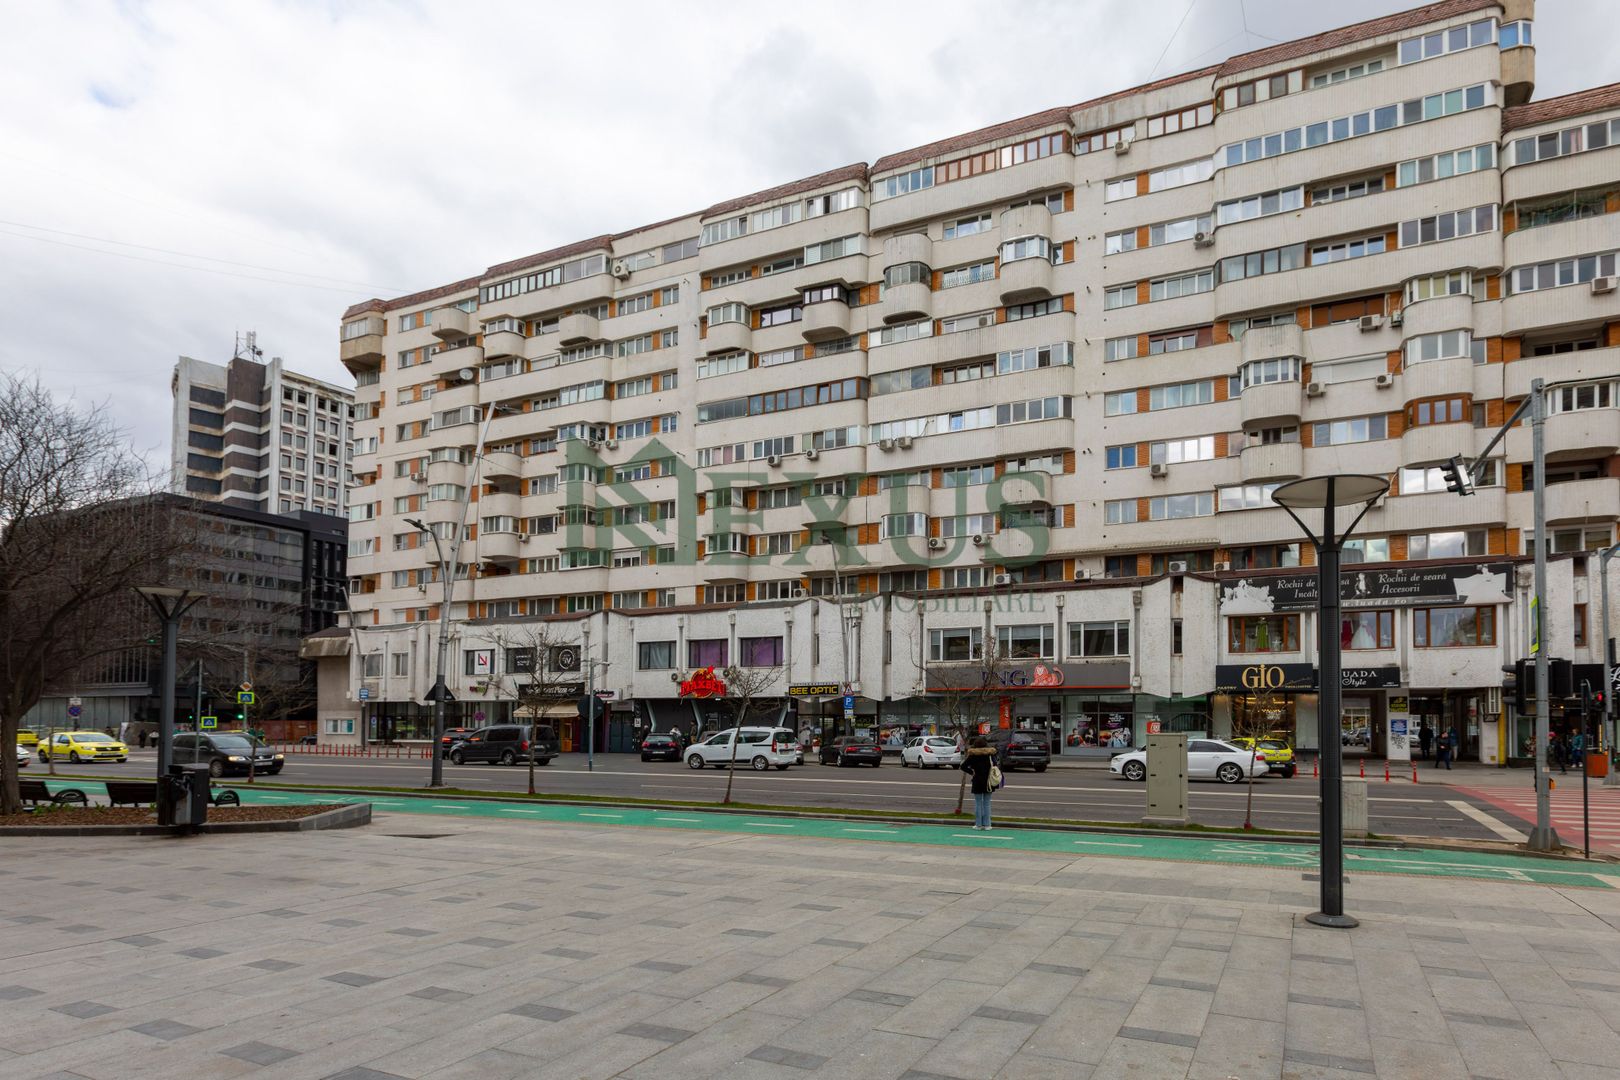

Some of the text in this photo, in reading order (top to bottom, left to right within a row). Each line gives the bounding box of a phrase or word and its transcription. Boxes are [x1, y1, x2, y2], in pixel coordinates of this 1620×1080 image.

[1378, 573, 1407, 584] Rochii
[1410, 572, 1420, 581] de
[1276, 579, 1315, 589] Rochii de
[1380, 583, 1420, 594] Accesorii
[1342, 675, 1367, 687] Style
[789, 686, 837, 695] BEE OPTIC
[845, 697, 852, 705] P
